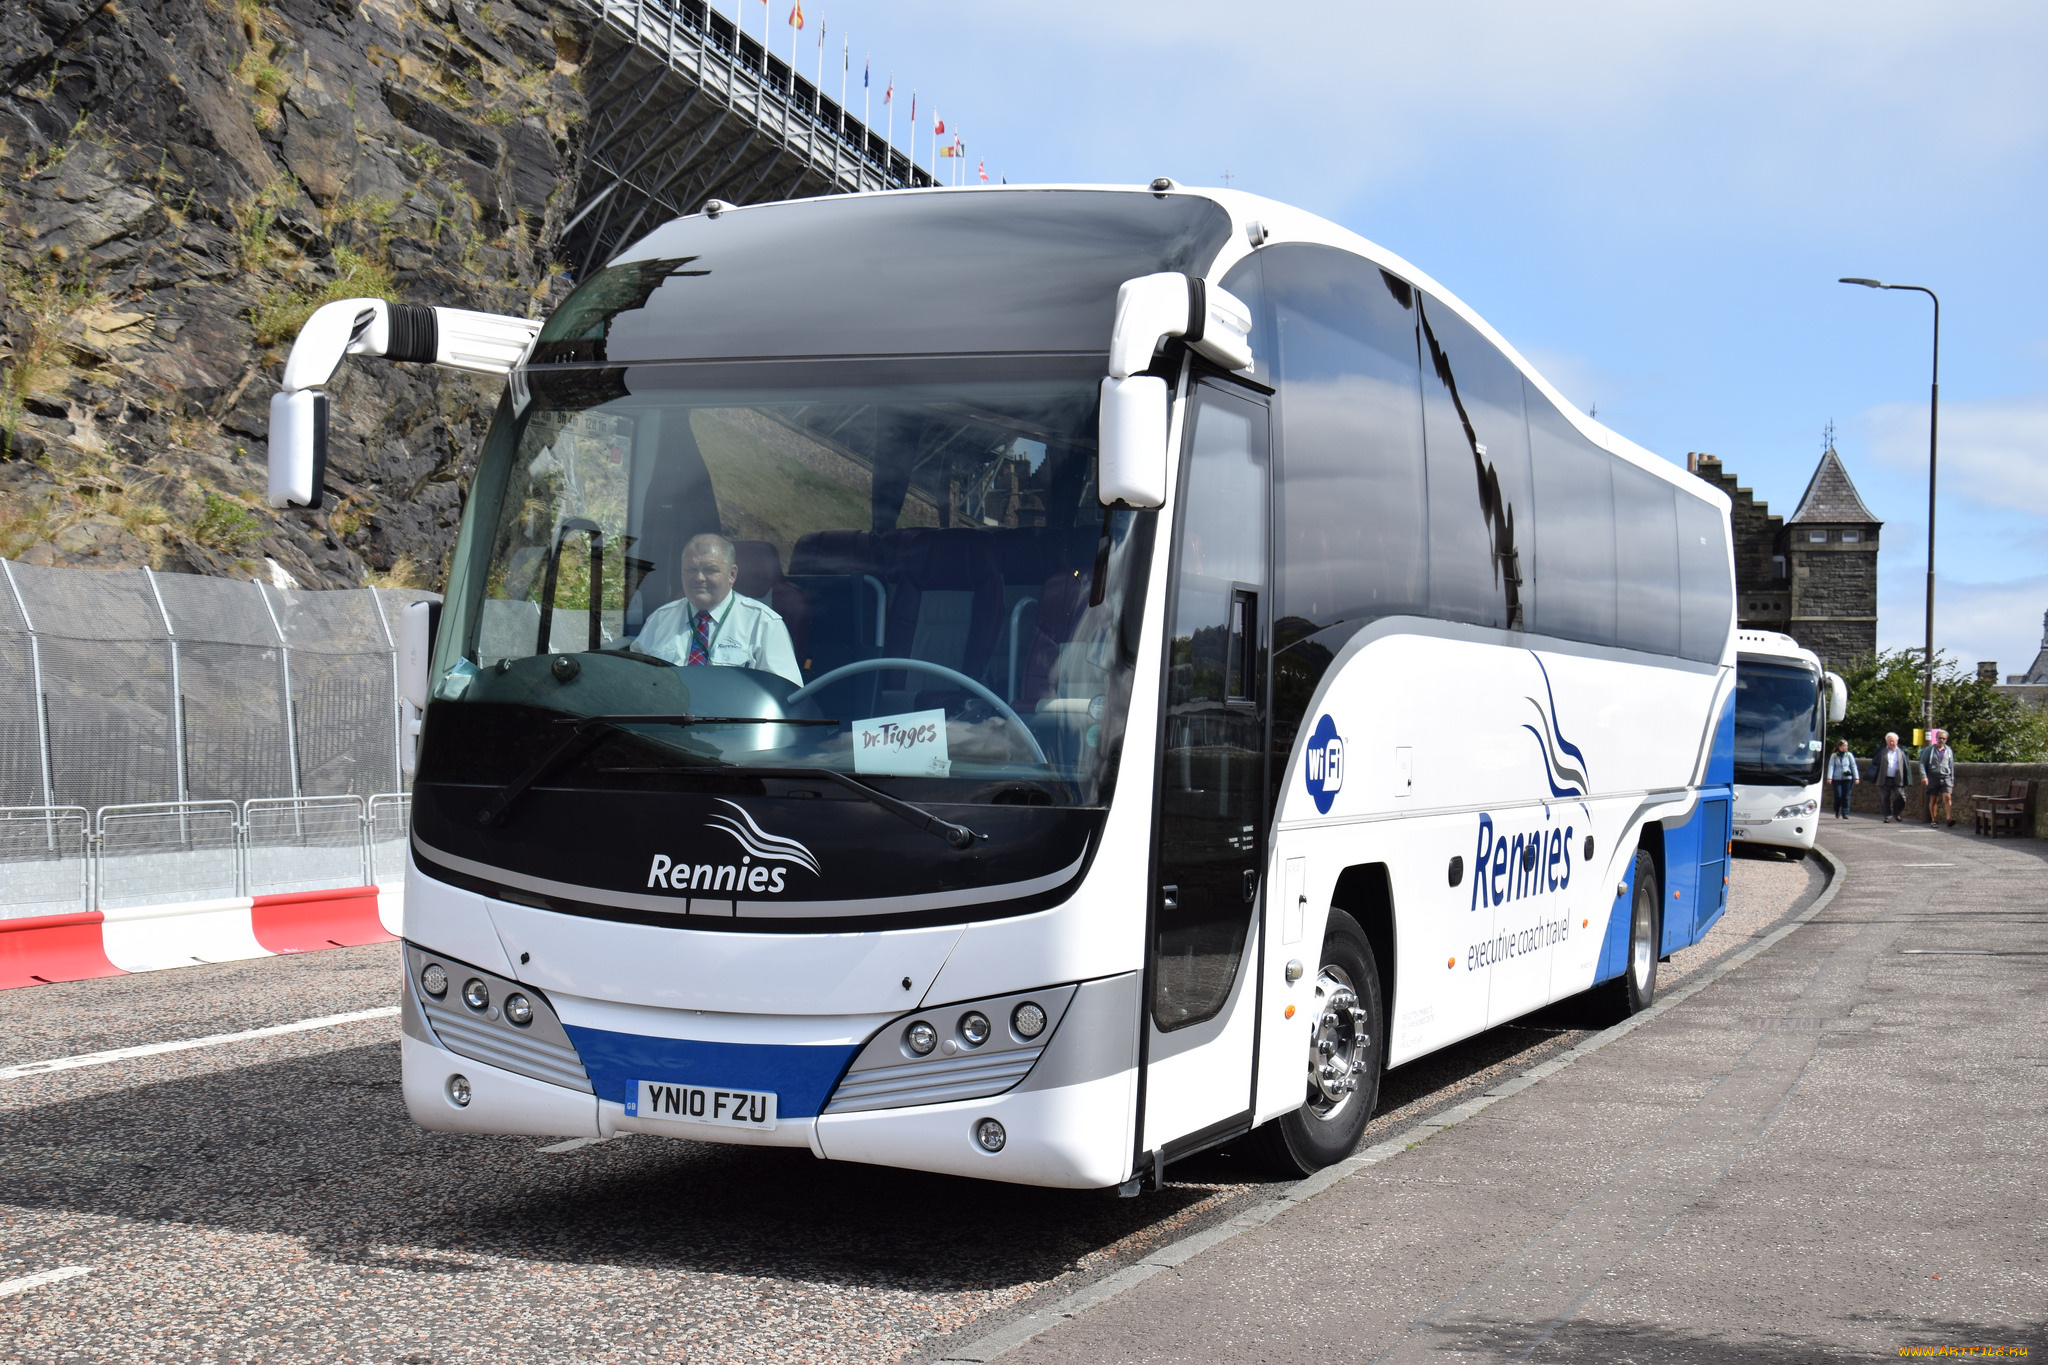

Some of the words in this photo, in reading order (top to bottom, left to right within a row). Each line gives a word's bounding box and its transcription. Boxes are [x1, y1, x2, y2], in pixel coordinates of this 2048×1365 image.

[879, 722, 937, 754] Tigges
[647, 854, 787, 893] Rennies
[1471, 804, 1573, 912] Rennies
[1468, 928, 1516, 972] executive
[1518, 915, 1544, 956] coach
[1546, 907, 1571, 947] travel
[626, 1102, 637, 1111] GB
[648, 1085, 706, 1117] YN10
[713, 1091, 767, 1123] FZU
